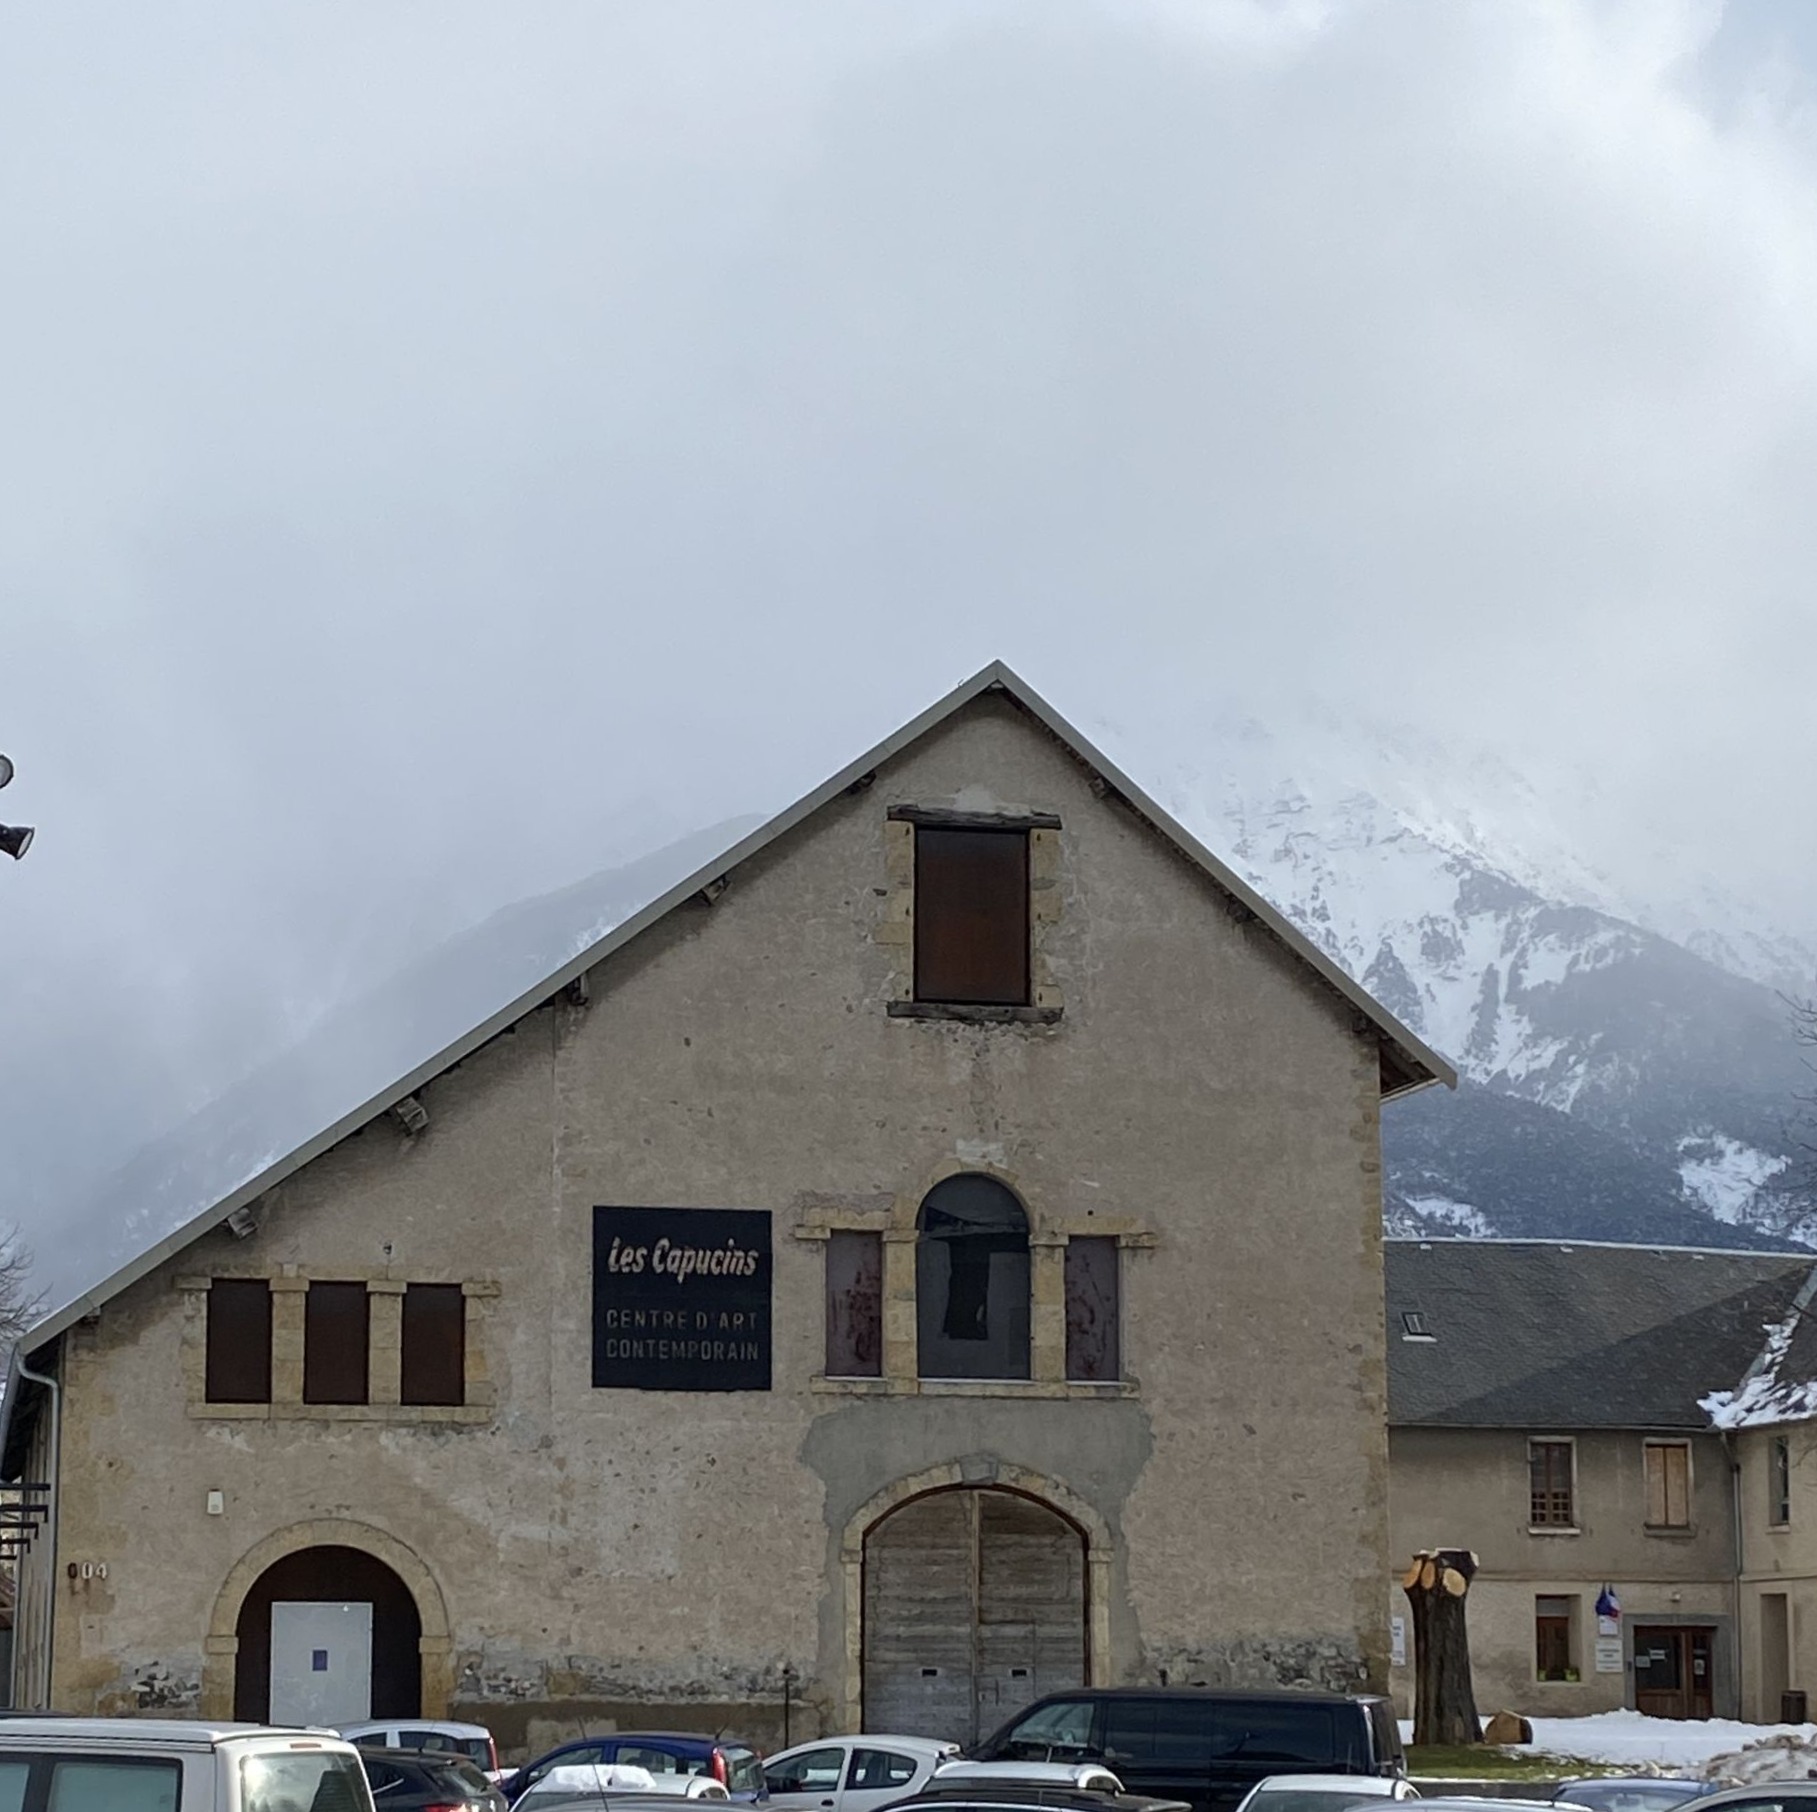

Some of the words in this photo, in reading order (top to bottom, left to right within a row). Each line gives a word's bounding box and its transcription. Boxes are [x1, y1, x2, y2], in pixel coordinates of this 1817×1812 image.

[652, 1237, 759, 1284] Capucins
[606, 1308, 687, 1330] CENTRE
[606, 1338, 759, 1361] CONTEMPORAIN
